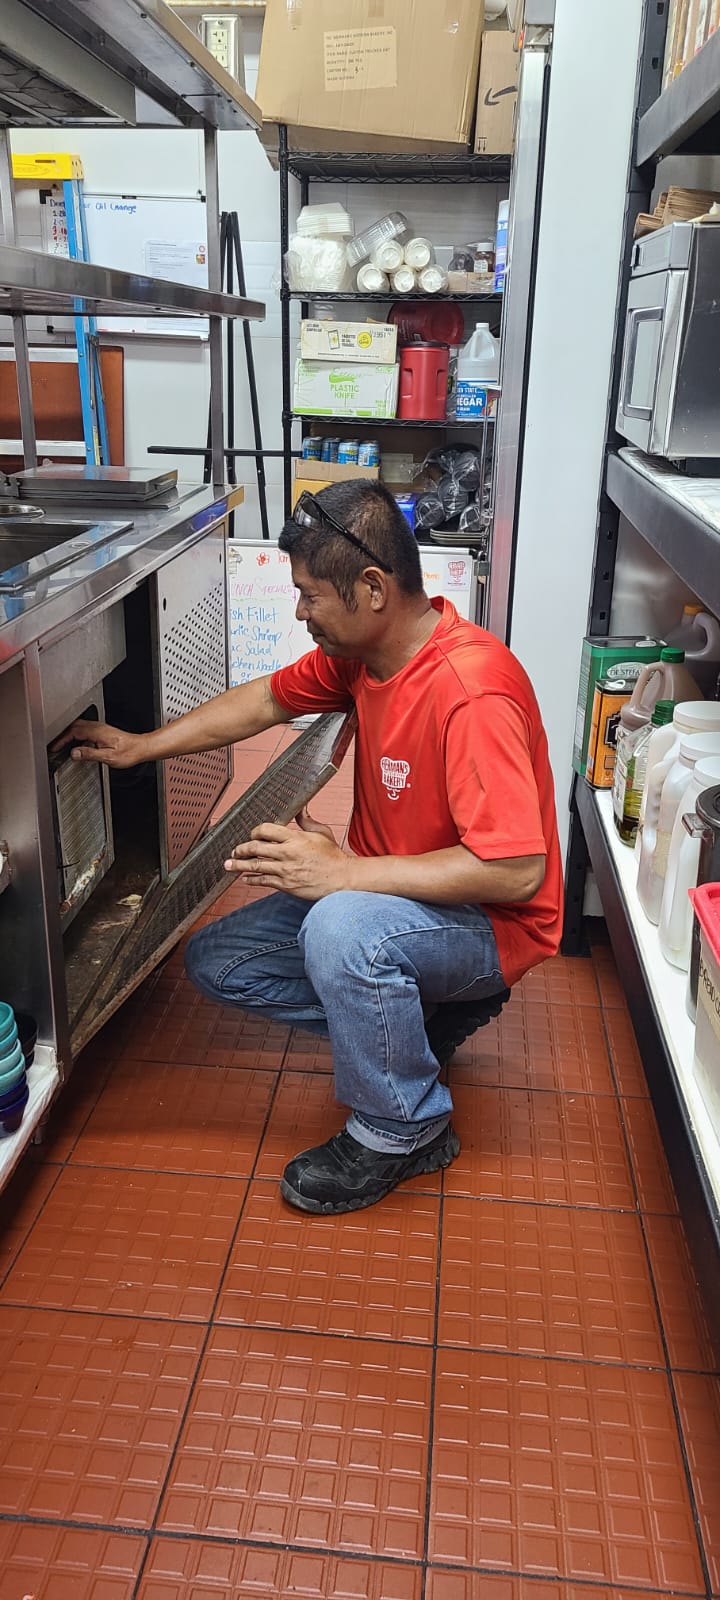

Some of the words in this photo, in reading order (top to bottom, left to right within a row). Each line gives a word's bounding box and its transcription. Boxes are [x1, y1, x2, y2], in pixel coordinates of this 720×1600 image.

[330, 383, 360, 393] PLASTIC
[334, 392, 355, 400] KNIFE
[247, 606, 280, 625] Fillet
[251, 625, 283, 647] Shrimp
[245, 641, 272, 656] Salad
[621, 668, 641, 676] STEFA
